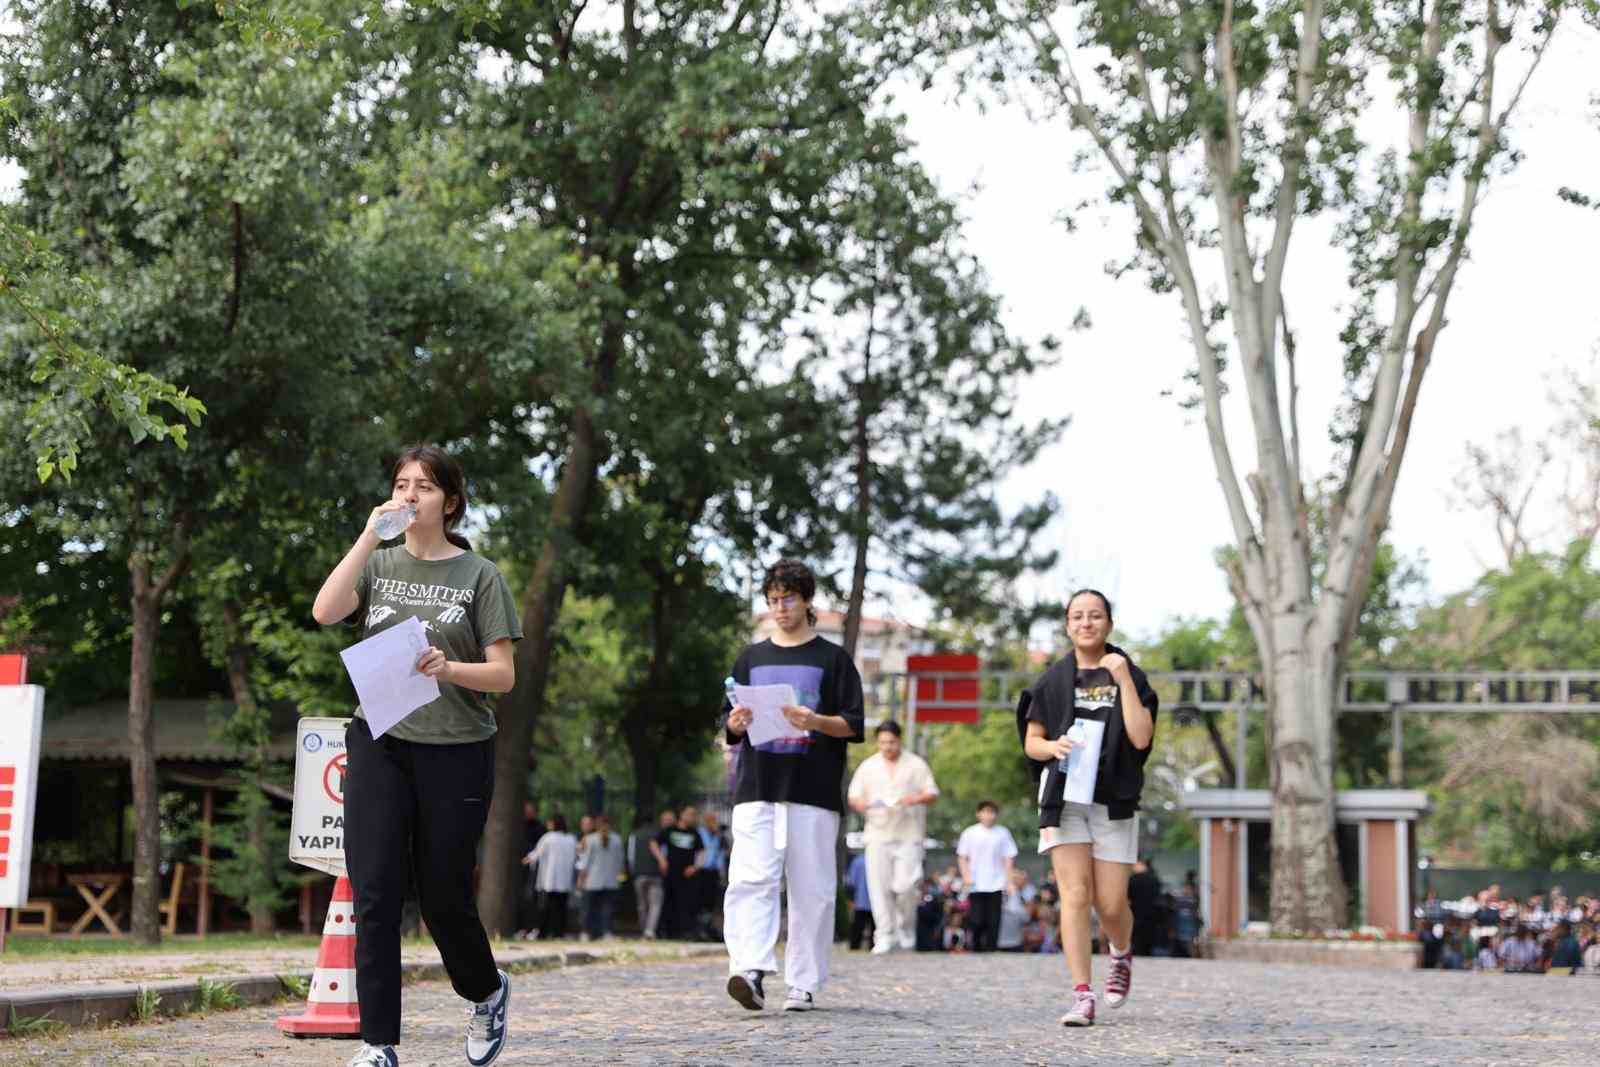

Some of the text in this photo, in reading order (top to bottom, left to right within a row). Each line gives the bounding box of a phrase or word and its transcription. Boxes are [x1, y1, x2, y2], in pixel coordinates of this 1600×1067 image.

[327, 740, 346, 749] HUK
[321, 815, 344, 829] PA
[298, 835, 344, 850] YAPI
